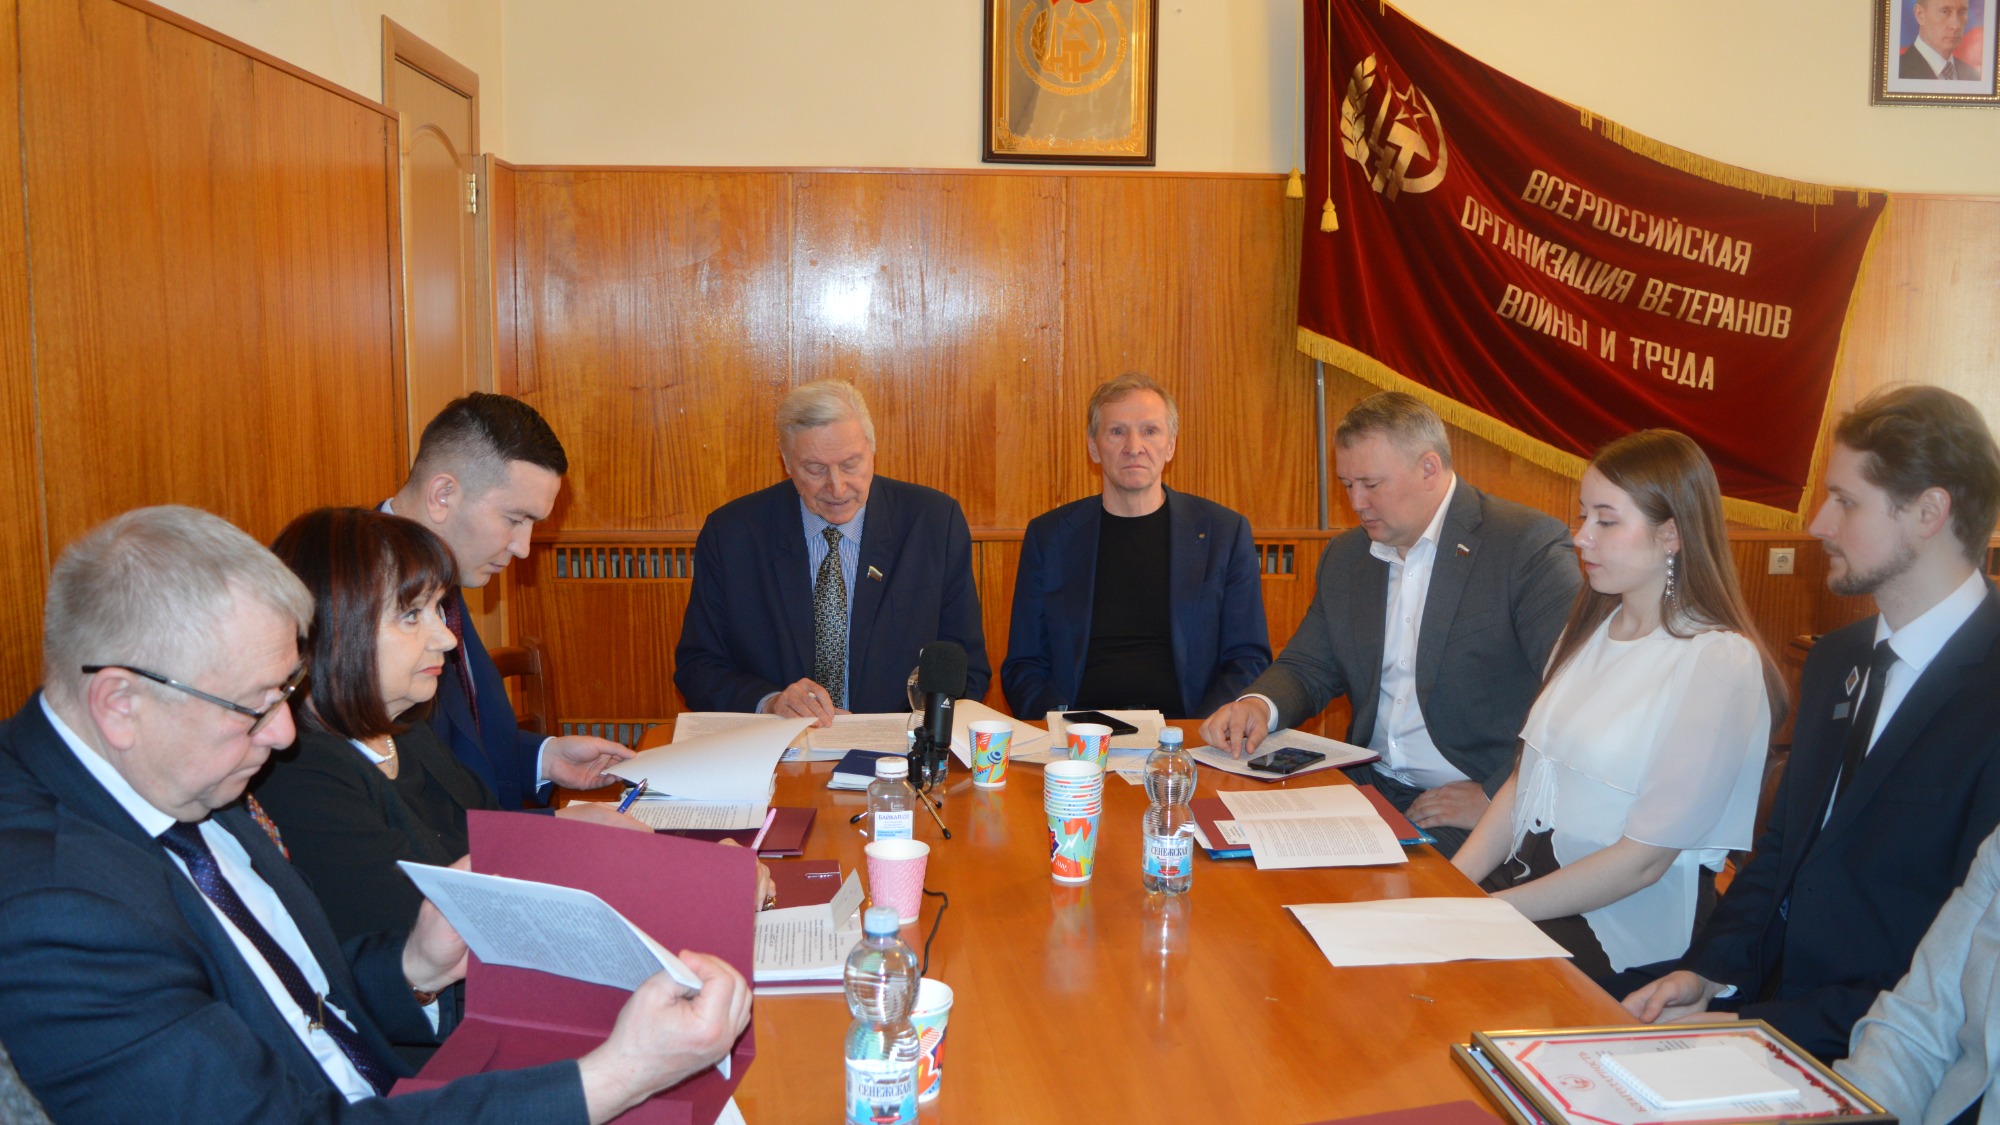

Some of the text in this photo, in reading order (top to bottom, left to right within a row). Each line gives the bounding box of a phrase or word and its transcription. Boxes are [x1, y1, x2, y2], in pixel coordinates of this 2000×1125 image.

[1461, 194, 1792, 339] ОРГАНИЗАЦИЯ ВЕТЕРАНОВ
[1521, 169, 1752, 275] ВСЕРОССИЙСКАЯ
[1496, 283, 1714, 391] ВОЙНЫ И ТРУДА
[1151, 846, 1188, 857] СЕНЕЖСКАЯ
[858, 1081, 912, 1098] СЕНЕЖСКАЯ
